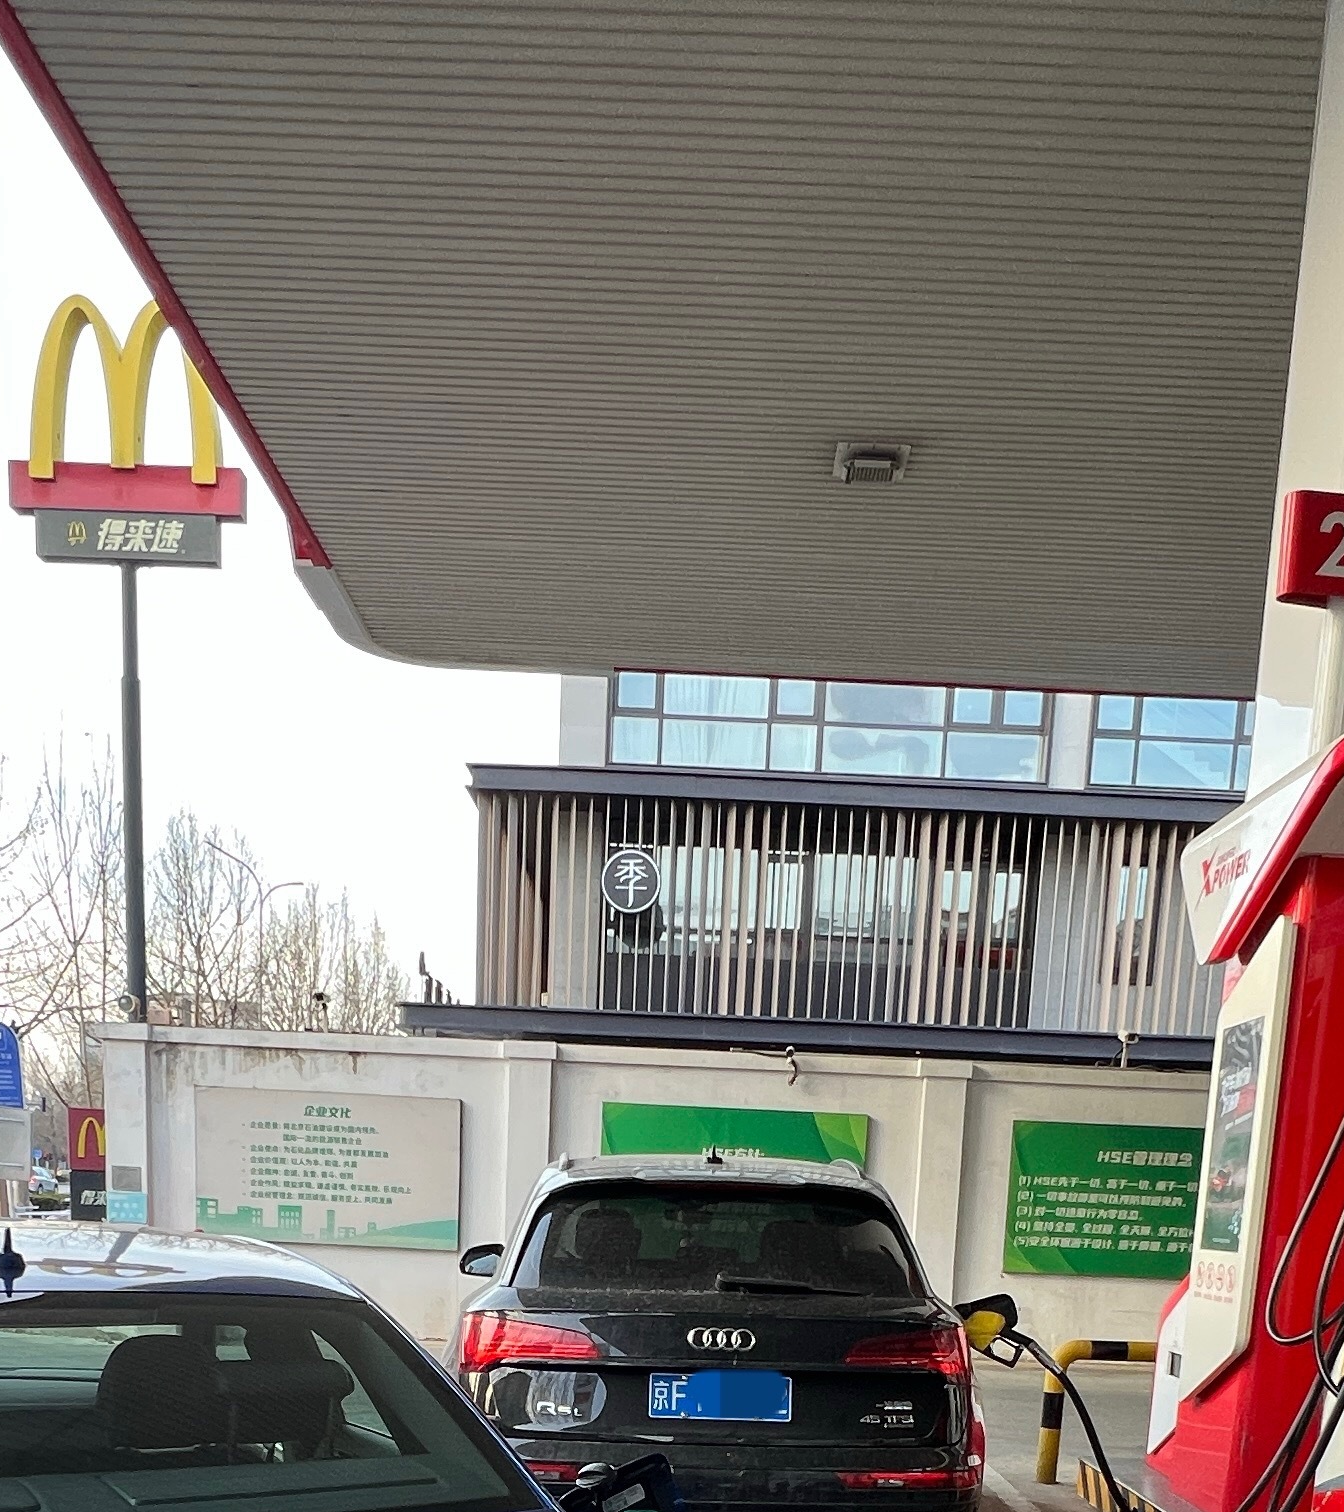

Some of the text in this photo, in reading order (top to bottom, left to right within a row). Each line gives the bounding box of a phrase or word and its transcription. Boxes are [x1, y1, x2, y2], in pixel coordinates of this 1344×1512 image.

[97, 518, 186, 554] 得来速
[614, 859, 649, 907] 季
[304, 1105, 352, 1119] 企业文化
